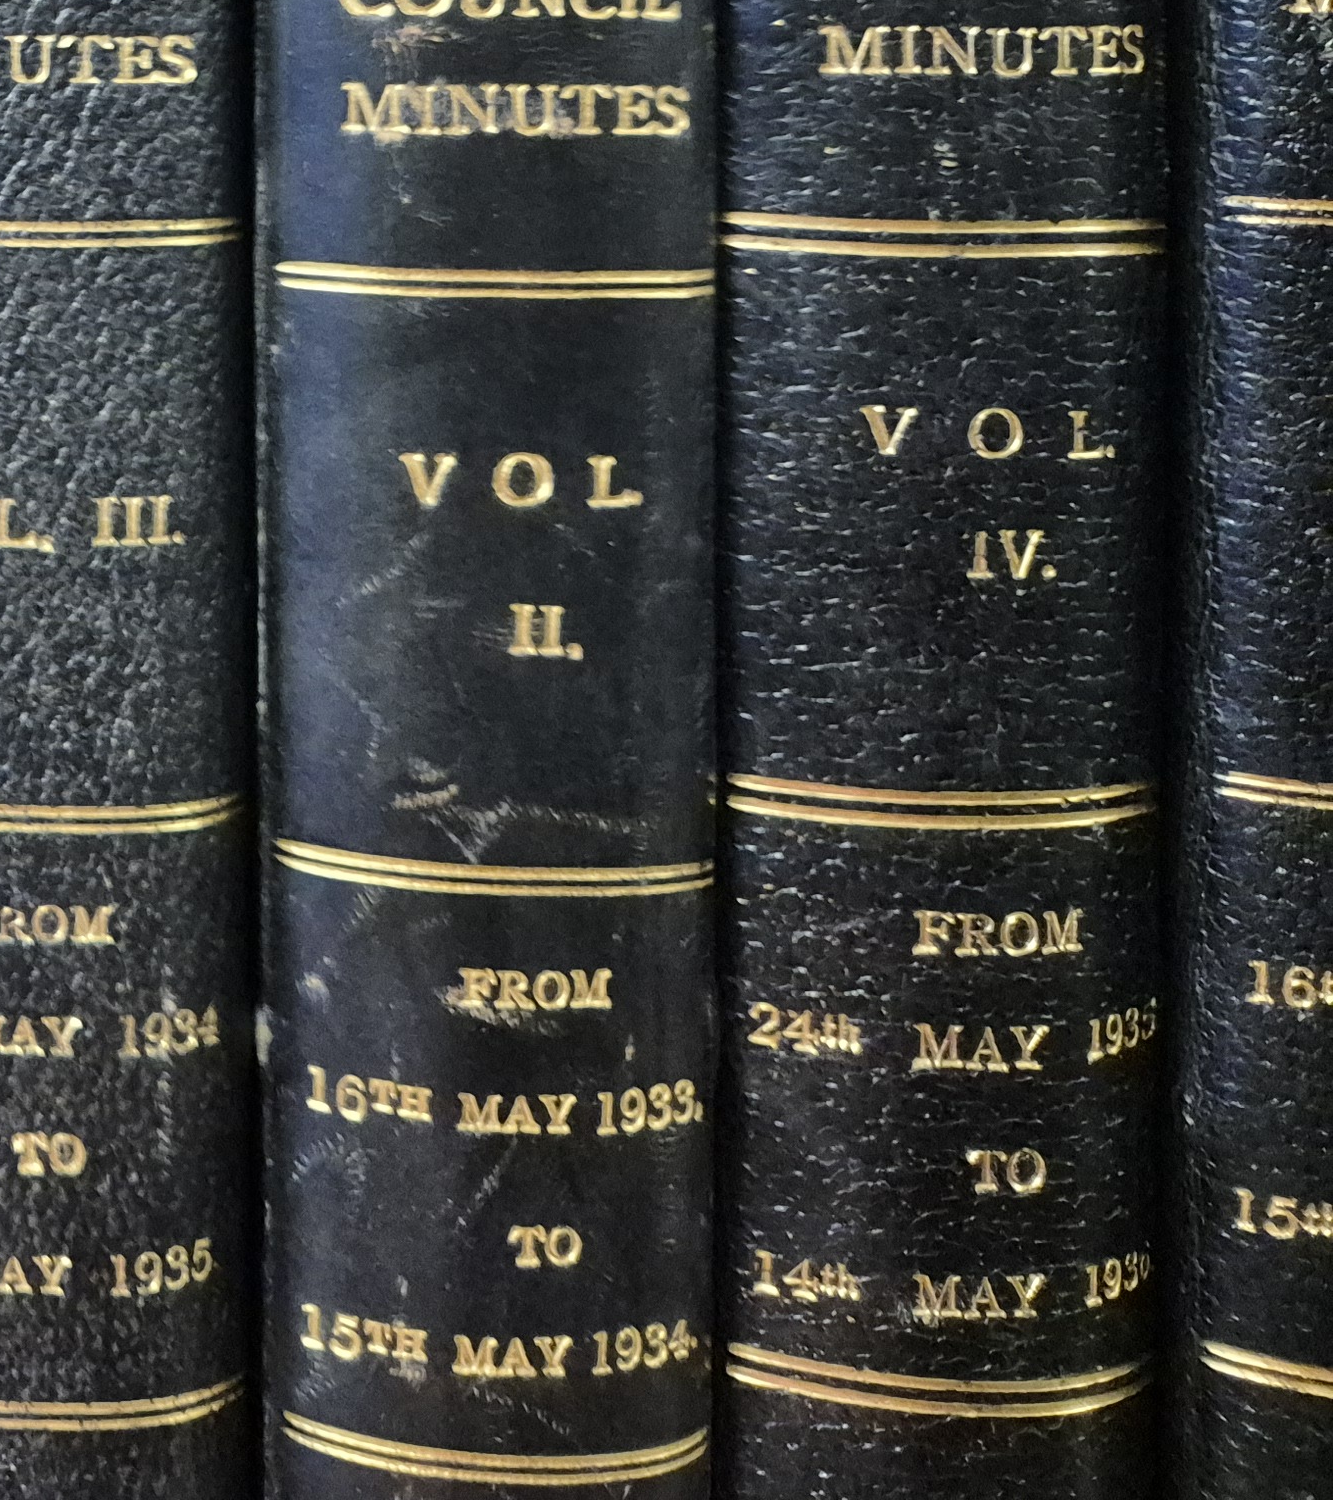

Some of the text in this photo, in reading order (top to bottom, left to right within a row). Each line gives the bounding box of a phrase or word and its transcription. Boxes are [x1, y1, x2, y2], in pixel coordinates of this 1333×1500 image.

[818, 25, 1144, 77] MINUTES
[340, 83, 690, 136] MINUTES
[92, 494, 185, 548] III.
[966, 530, 1057, 579] IV.
[508, 603, 583, 660] II.
[912, 910, 1083, 956] FROM
[458, 967, 612, 1010] FROM
[1245, 960, 1333, 1009] 16t
[119, 1005, 219, 1059] 1934
[747, 1002, 862, 1055] 24th
[911, 1022, 1049, 1072] MAY
[306, 1065, 433, 1123] 16TH
[457, 1093, 577, 1135] MAY
[11, 1132, 87, 1177] TO
[966, 1148, 1047, 1194] TO
[110, 1238, 212, 1297] 1935
[507, 1225, 582, 1268] TO
[753, 1249, 860, 1301] 14th
[912, 1273, 1045, 1326] MAY
[301, 1303, 697, 1377] 15TH MAY 1934.
